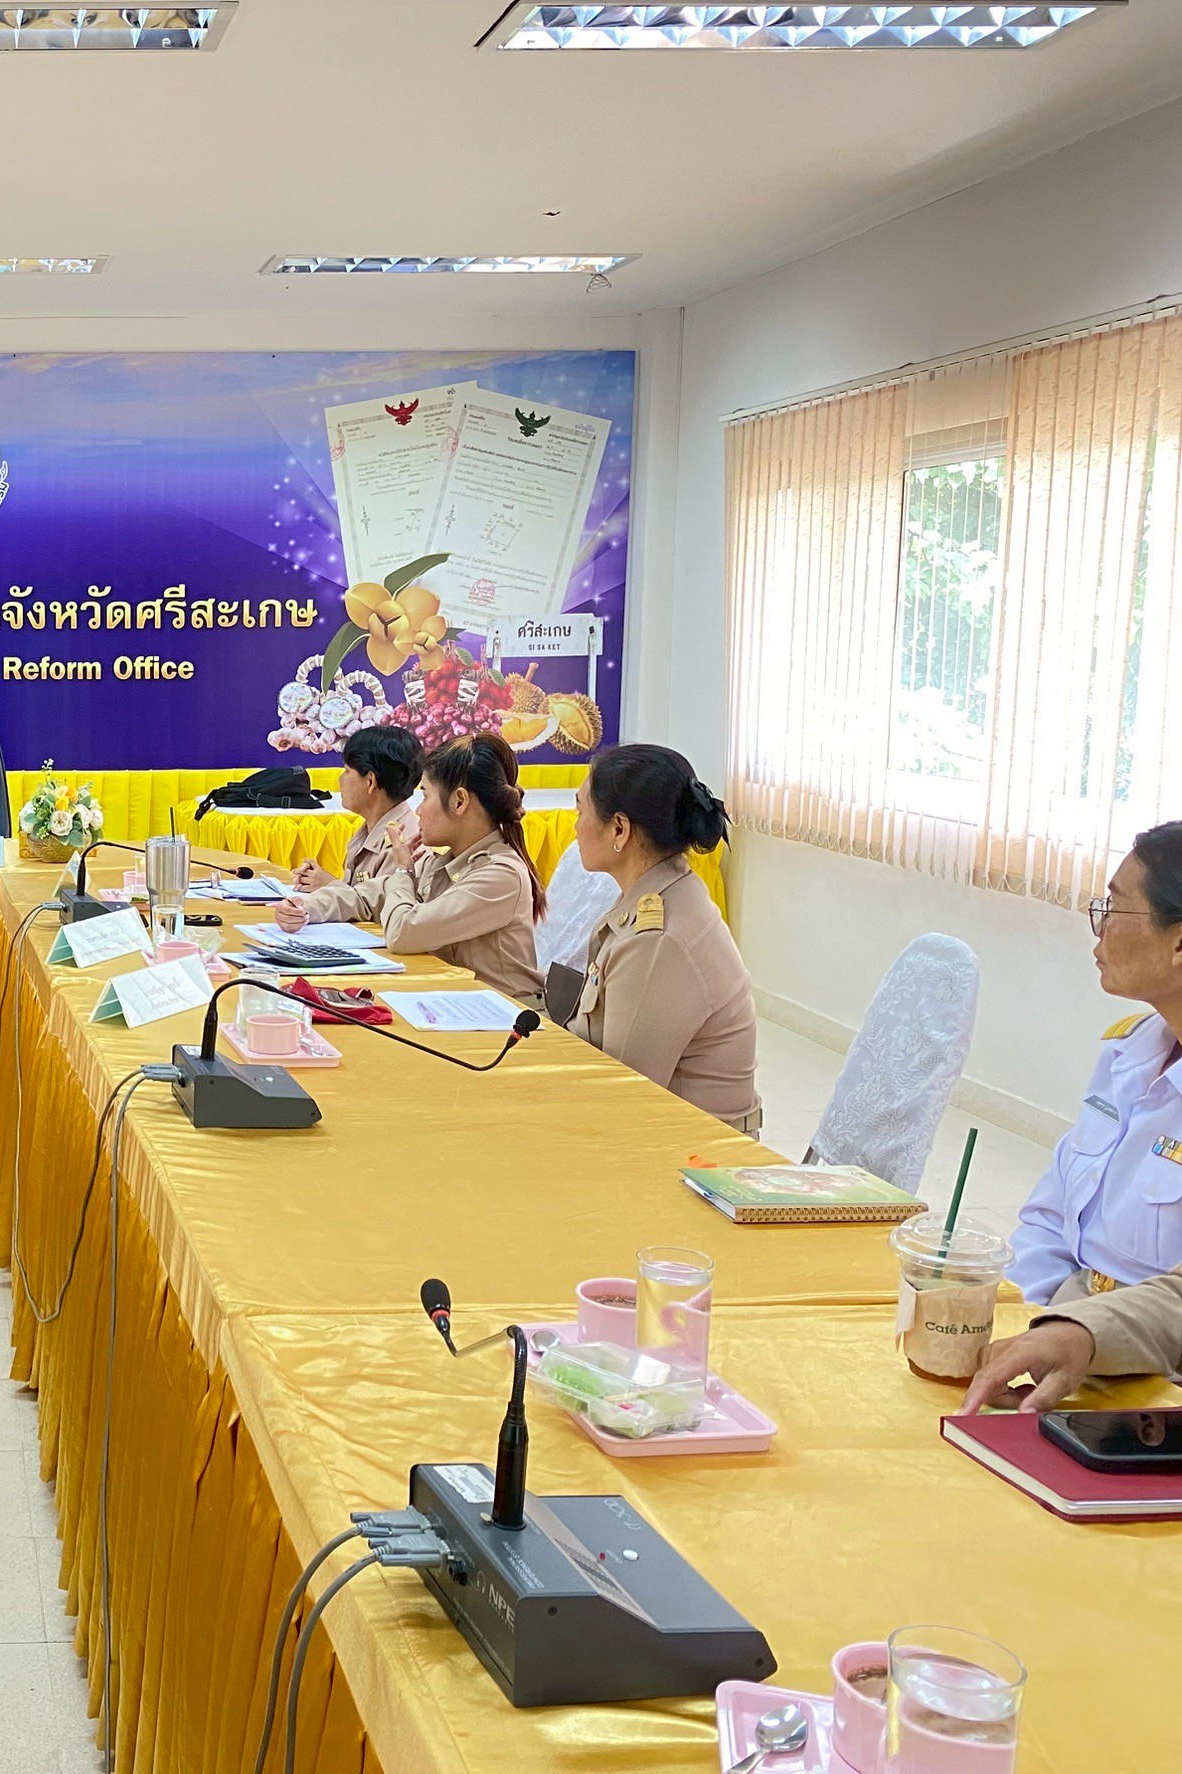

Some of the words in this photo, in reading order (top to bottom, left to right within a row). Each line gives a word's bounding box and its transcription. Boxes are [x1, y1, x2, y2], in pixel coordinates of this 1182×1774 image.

[518, 620, 572, 638] ศรีสะเกษ
[3, 656, 102, 680] Reform
[113, 655, 195, 680] Office
[925, 1321, 958, 1335] Café
[488, 1583, 516, 1629] NPE
